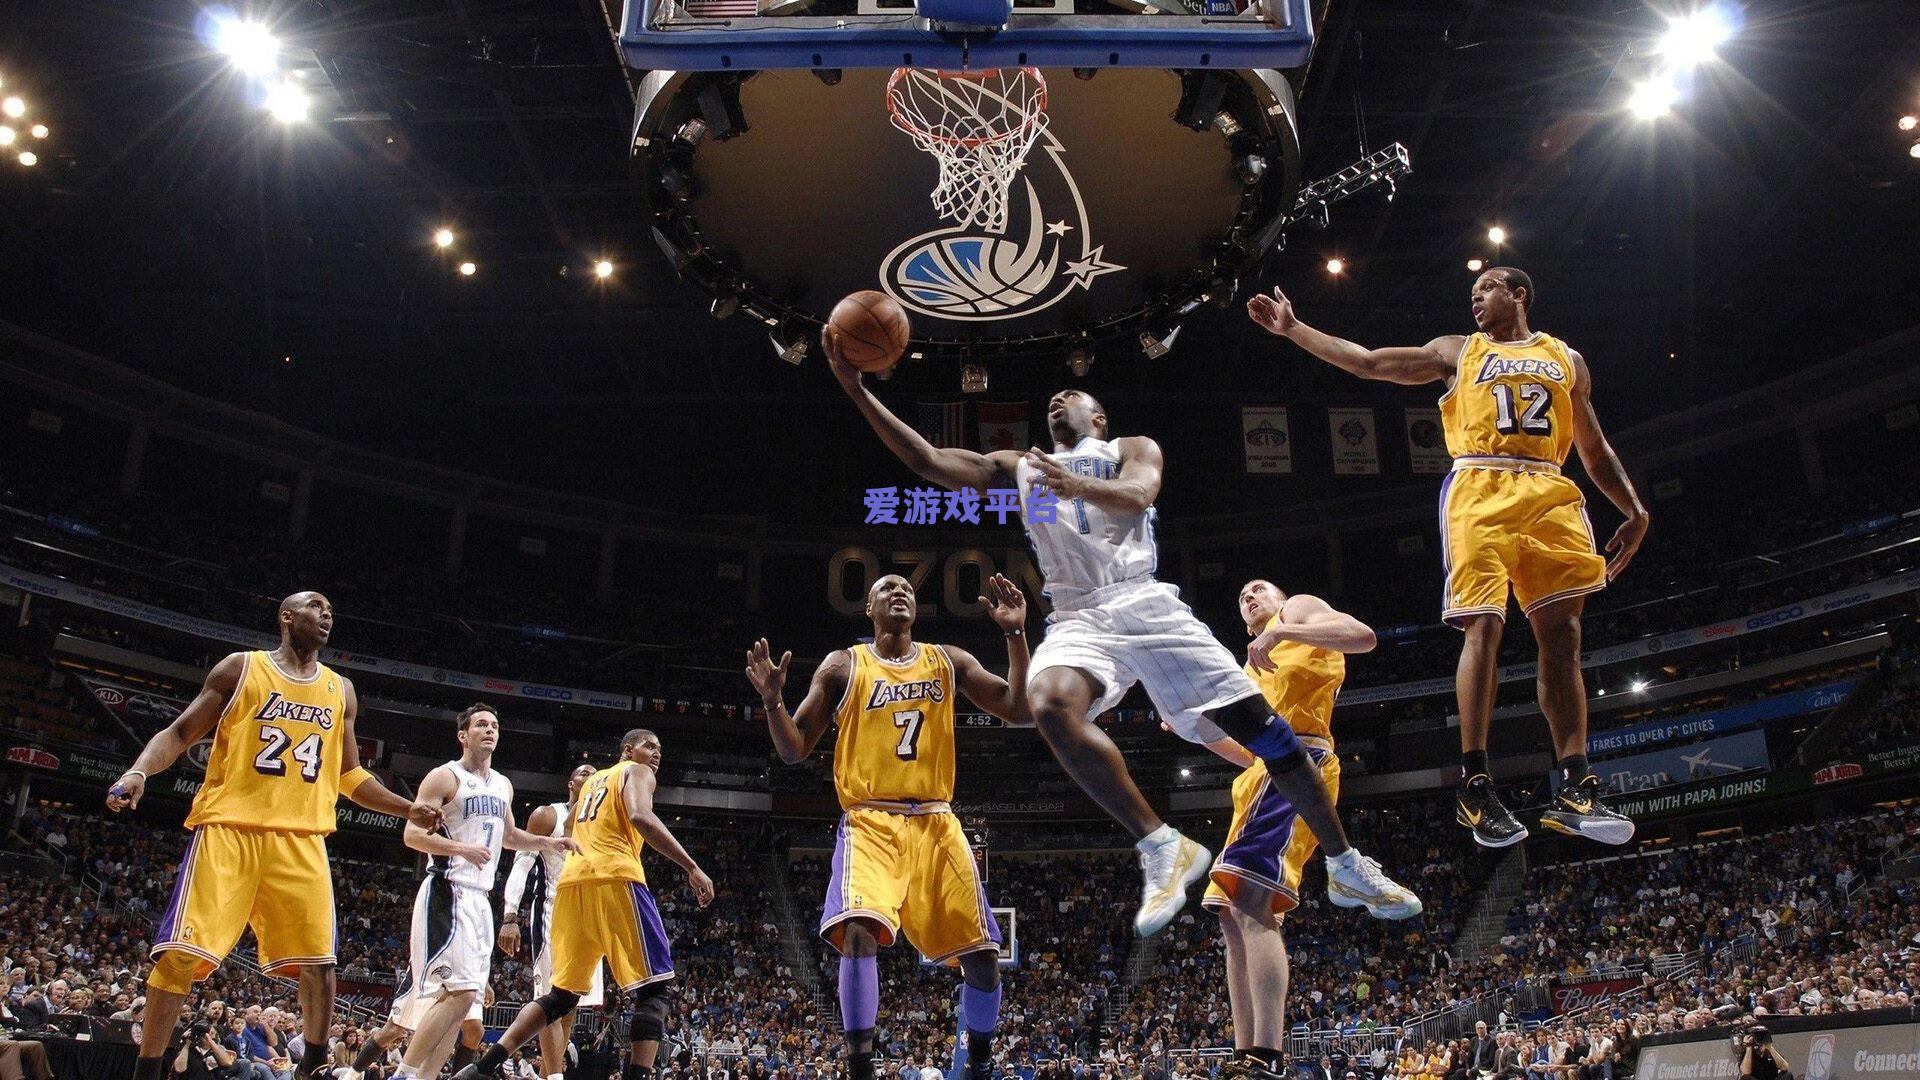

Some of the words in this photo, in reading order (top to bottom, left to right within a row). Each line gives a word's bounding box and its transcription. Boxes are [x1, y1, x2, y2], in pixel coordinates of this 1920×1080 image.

[1211, 3, 1232, 13] NBA
[1475, 353, 1565, 384] LAKERS
[1492, 383, 1552, 437] 12
[1072, 499, 1090, 534] 1
[10, 577, 58, 596] PEPSICO
[1747, 606, 1804, 630] GEICO
[1823, 592, 1871, 611] PEPSICO
[1505, 665, 1537, 677] Amway
[99, 690, 119, 702] KIA
[522, 685, 573, 700] GEICO
[589, 697, 627, 708] PEPSICO
[865, 679, 945, 711] LAKERS
[254, 692, 334, 731] LAKERS
[966, 715, 992, 726] 4:52
[893, 709, 925, 761] 7
[1593, 736, 1622, 752] FARES
[1624, 733, 1637, 746] TO
[1639, 728, 1665, 743] OVER
[1682, 719, 1714, 735] CITIES
[70, 752, 95, 767] Better
[254, 724, 324, 784] 24
[1868, 750, 1895, 762] Better
[1897, 744, 1920, 757] Ingre
[1884, 758, 1911, 769] Better
[81, 765, 105, 779] Better
[1611, 770, 1668, 794] Tran
[463, 794, 506, 820] MAGI
[983, 802, 1037, 813] BASELINE
[1039, 802, 1064, 813] BAR
[1618, 800, 1644, 816] WIN
[1649, 794, 1681, 813] WITH
[1685, 787, 1716, 806] PAPA
[1719, 778, 1767, 799] JOHNS!
[355, 811, 400, 829] JOHNS!
[482, 821, 495, 849] 7
[1658, 1061, 1699, 1079] Connect
[1700, 1060, 1713, 1077] at
